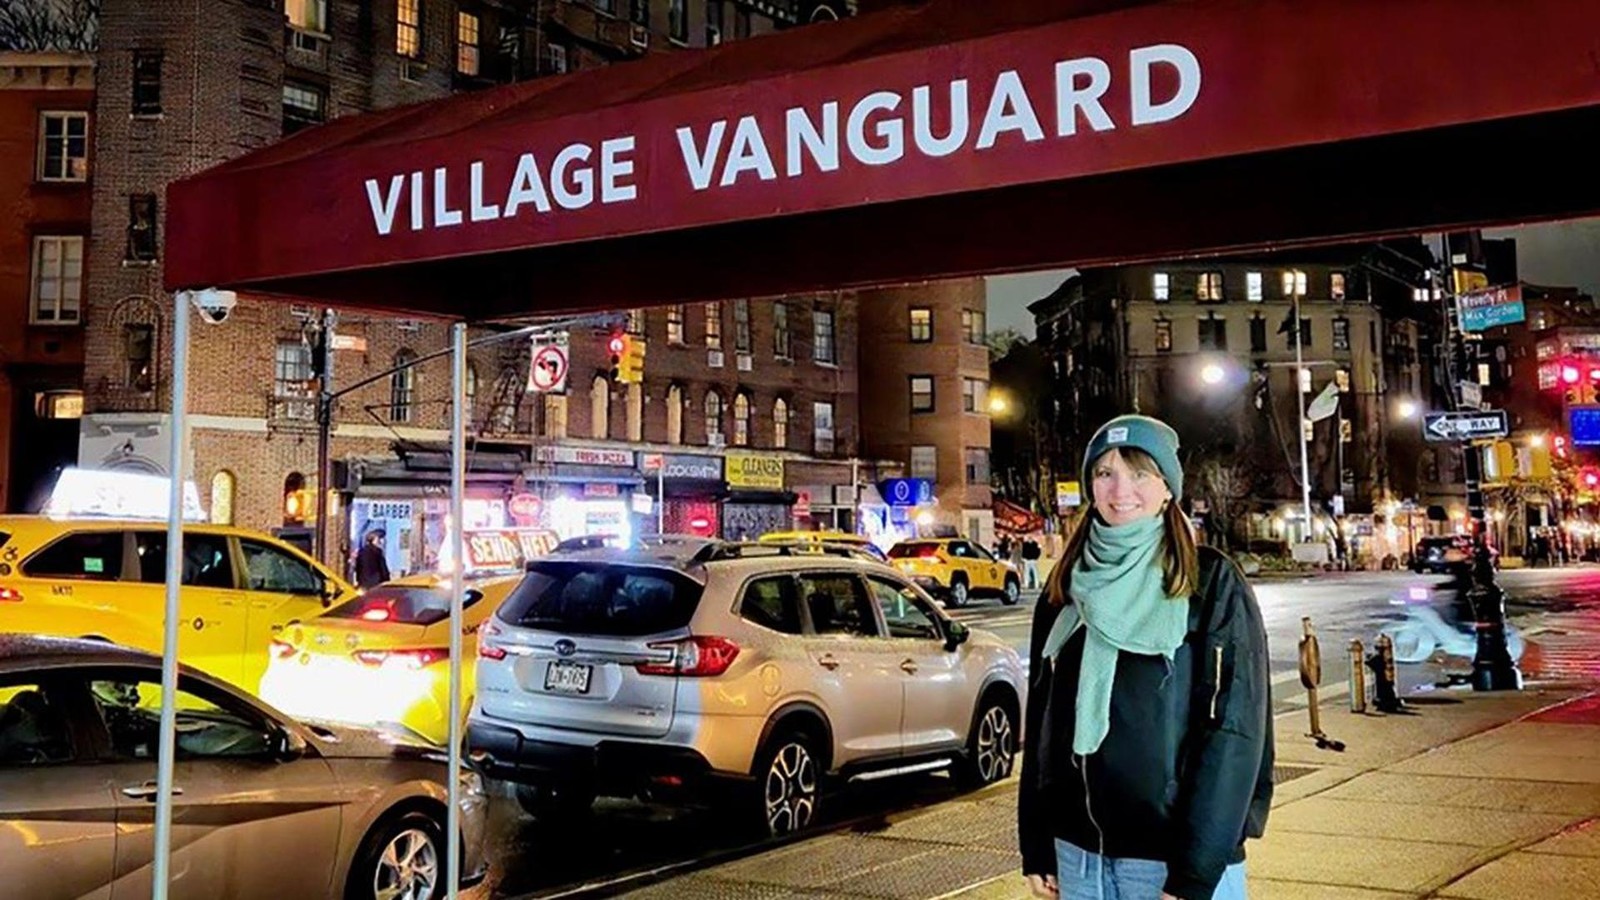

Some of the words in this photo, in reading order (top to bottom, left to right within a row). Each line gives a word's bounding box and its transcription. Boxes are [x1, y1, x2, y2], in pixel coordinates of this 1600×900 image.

[365, 136, 637, 235] VILLAGE
[677, 43, 1202, 190] VANGUARD
[1437, 420, 1457, 431] ONE
[1470, 419, 1494, 429] WAY
[742, 457, 781, 475] CLEANERS
[373, 503, 411, 518] BARBER
